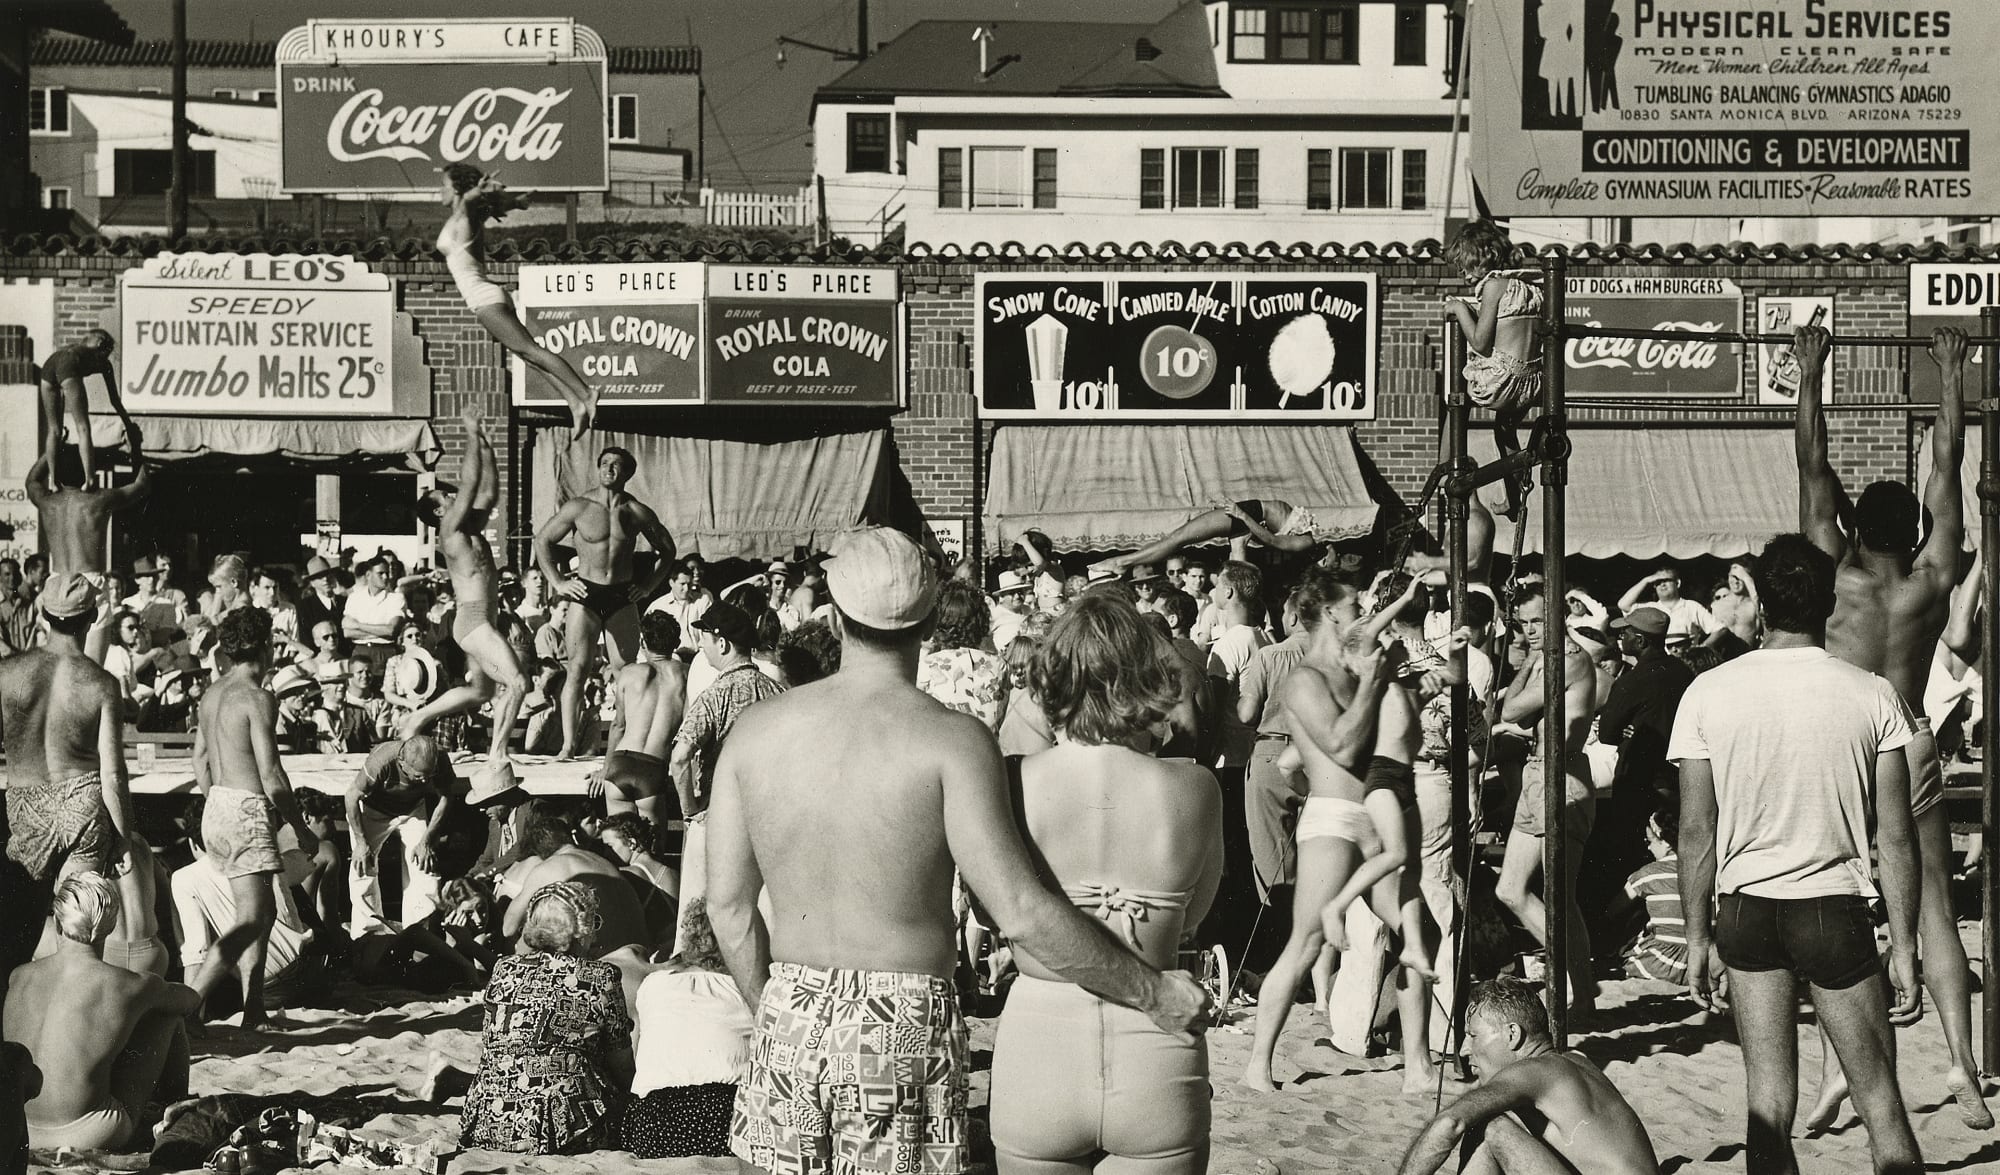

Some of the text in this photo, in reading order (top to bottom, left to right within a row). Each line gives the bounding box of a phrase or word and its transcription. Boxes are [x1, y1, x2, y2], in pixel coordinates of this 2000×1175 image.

[1634, 0, 1950, 39] PHYSICAL SERVICES
[327, 27, 560, 48] KHOURY'S CAFE
[1892, 47, 1951, 56] SAFE
[1650, 57, 1930, 80] Men Women Children All Ages
[293, 77, 356, 92] DRINK
[1634, 84, 1950, 104] TUMBLING BALANCING GYMNASTICS ADAGIO
[327, 86, 573, 162] Coca-Cola
[1620, 109, 1660, 121] 10830
[1670, 109, 1712, 120] SANTA
[1720, 109, 1785, 120] MONICA
[1847, 109, 1910, 120] ARIZONA
[1918, 109, 1961, 120] 75229
[1592, 137, 1961, 167] CONDITIONING & DEVELOPMENT
[1516, 168, 1971, 209] Complete GYMNASIUM FACILITIES Reasonable RATES
[156, 257, 345, 283] Silent LEO'S
[734, 270, 871, 293] LEO'S PLACE
[545, 271, 677, 293] LEO'S PLACE
[1590, 279, 1623, 293] DOGS
[1634, 279, 1724, 294] HAMBURGERS
[1928, 273, 2000, 306] EDDI
[188, 297, 316, 315] SPEEDY
[537, 311, 573, 320] DRINK
[725, 309, 762, 318] DRINK
[988, 286, 1101, 323] SNOW CONE
[1120, 287, 1230, 322] CANDIED APPLE
[1249, 287, 1363, 323] COTTON CANDY
[135, 320, 373, 347] FOUNTAIN SERVICE
[610, 315, 696, 361] CROWN
[715, 316, 888, 363] ROYAL CROWN
[1565, 320, 1724, 369] CocaCola
[127, 353, 250, 397] Jumbo
[259, 354, 330, 399] Malts
[582, 355, 639, 377] COLA
[772, 355, 831, 377] COLA
[604, 384, 664, 393] TASTE-TEST
[746, 385, 857, 394] BEST BY TASTE-TEST
